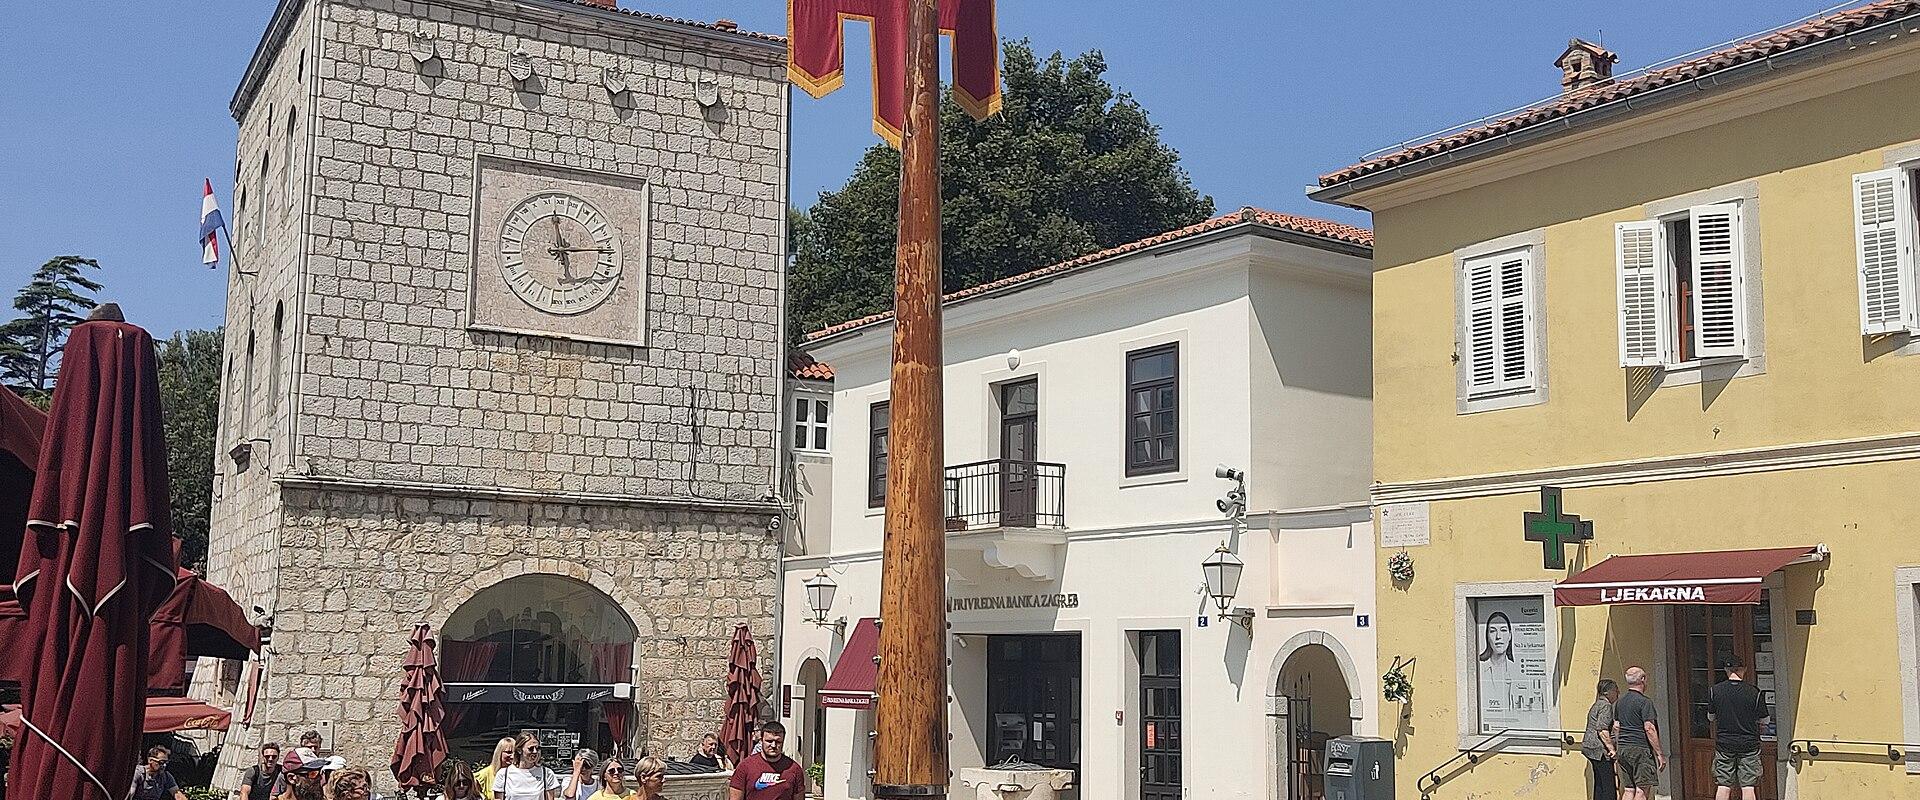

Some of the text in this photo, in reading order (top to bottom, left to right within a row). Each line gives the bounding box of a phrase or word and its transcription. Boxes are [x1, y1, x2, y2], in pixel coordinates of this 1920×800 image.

[1600, 586, 1706, 602] LJEKARNA
[953, 593, 1078, 611] PRIVREDNA BANKA ZAGREB
[1359, 617, 1366, 626] 3
[760, 772, 781, 783] NIKE
